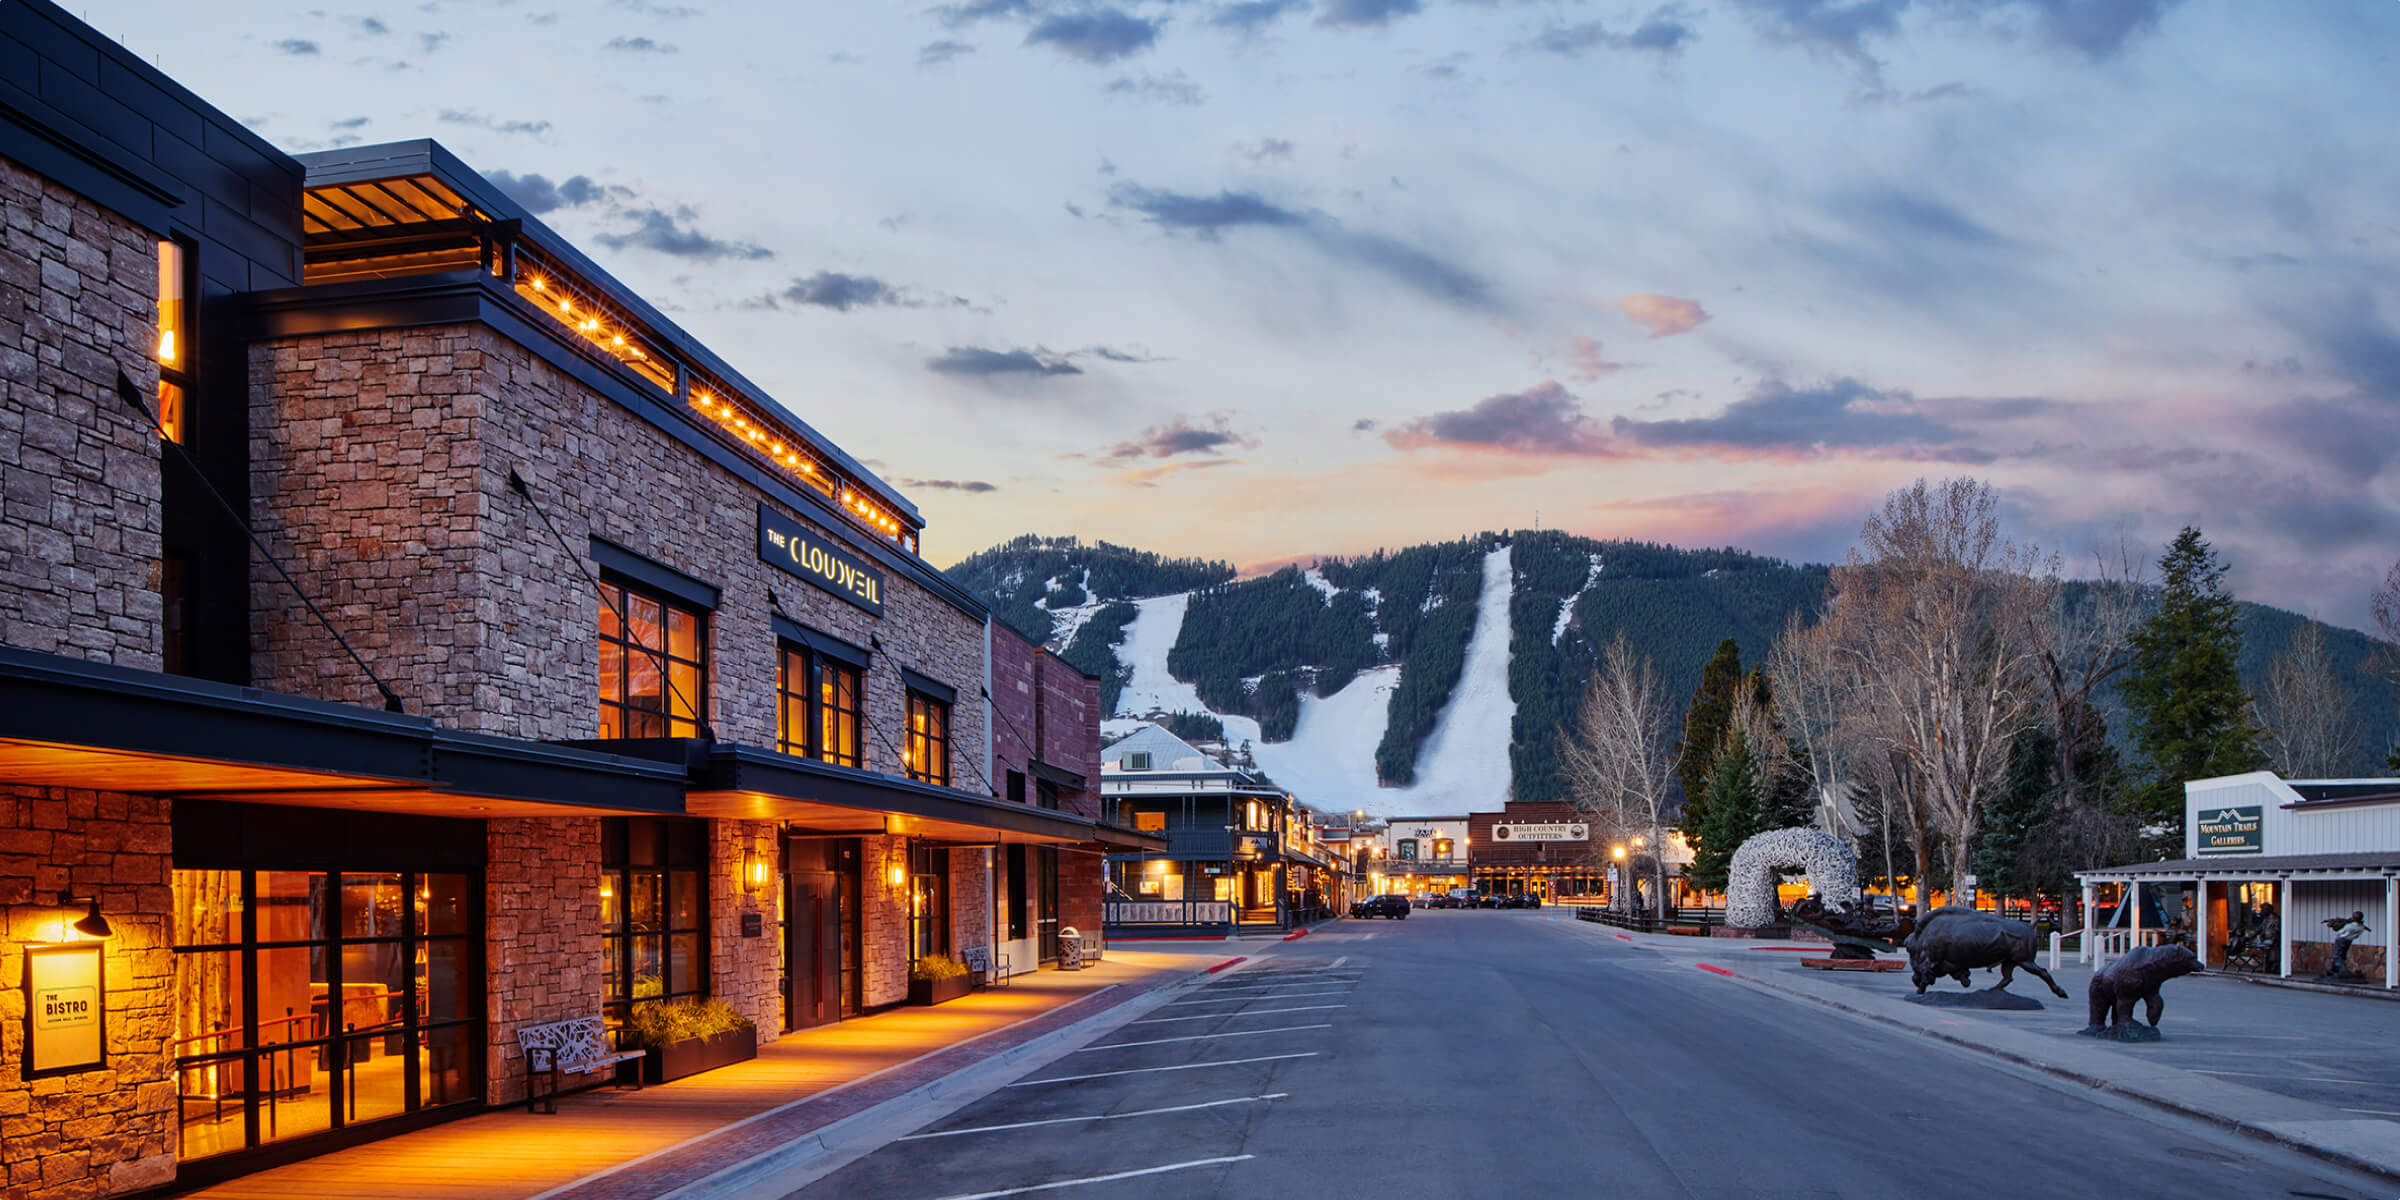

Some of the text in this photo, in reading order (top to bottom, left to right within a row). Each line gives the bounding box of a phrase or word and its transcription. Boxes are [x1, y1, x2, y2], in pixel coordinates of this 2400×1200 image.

[767, 529, 880, 605] THE CLOUDVEIL
[1513, 825, 1566, 833] HIGH COUNTRY
[2200, 822, 2257, 833] MOUNTAIN TRAILS
[2211, 835, 2245, 845] GALLERIES
[46, 1000, 87, 1015] BISTRO
